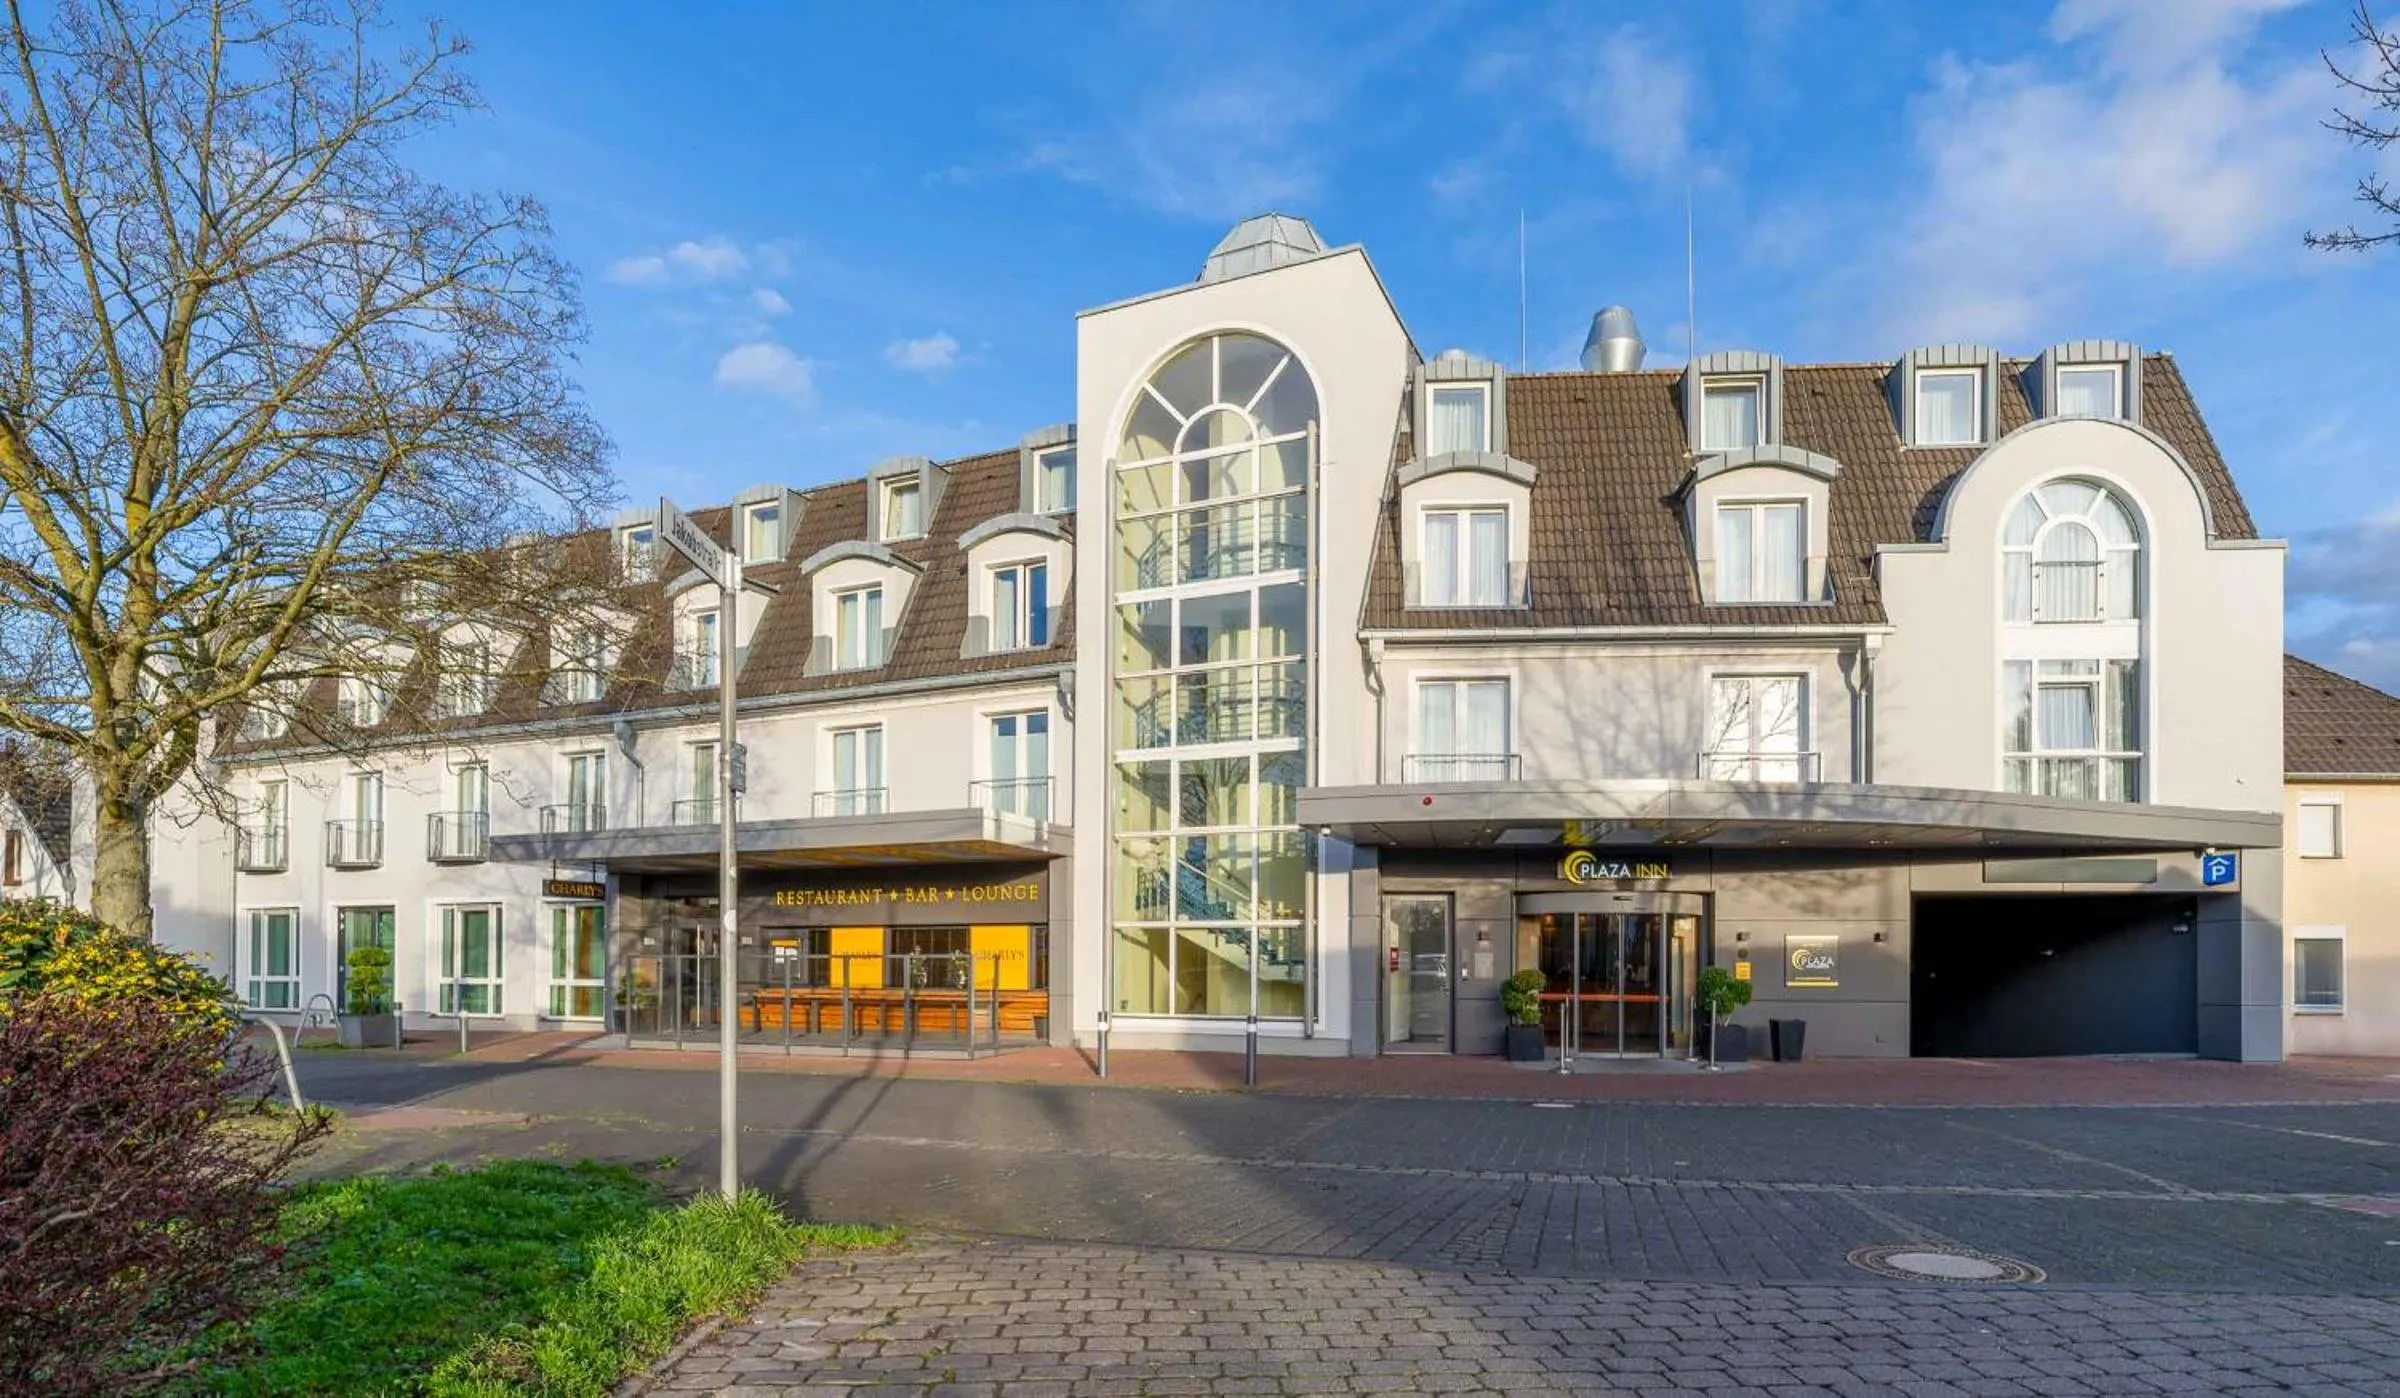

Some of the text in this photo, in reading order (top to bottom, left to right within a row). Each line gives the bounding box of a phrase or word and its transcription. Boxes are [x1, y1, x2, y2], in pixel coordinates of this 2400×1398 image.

[671, 511, 721, 571] Jakobstraß
[1581, 863, 1667, 878] PLAZA INN
[2212, 865, 2226, 881] P
[776, 884, 1038, 905] RESTAURANT BAR LOUNGE
[1801, 955, 1834, 968] PLAZA
